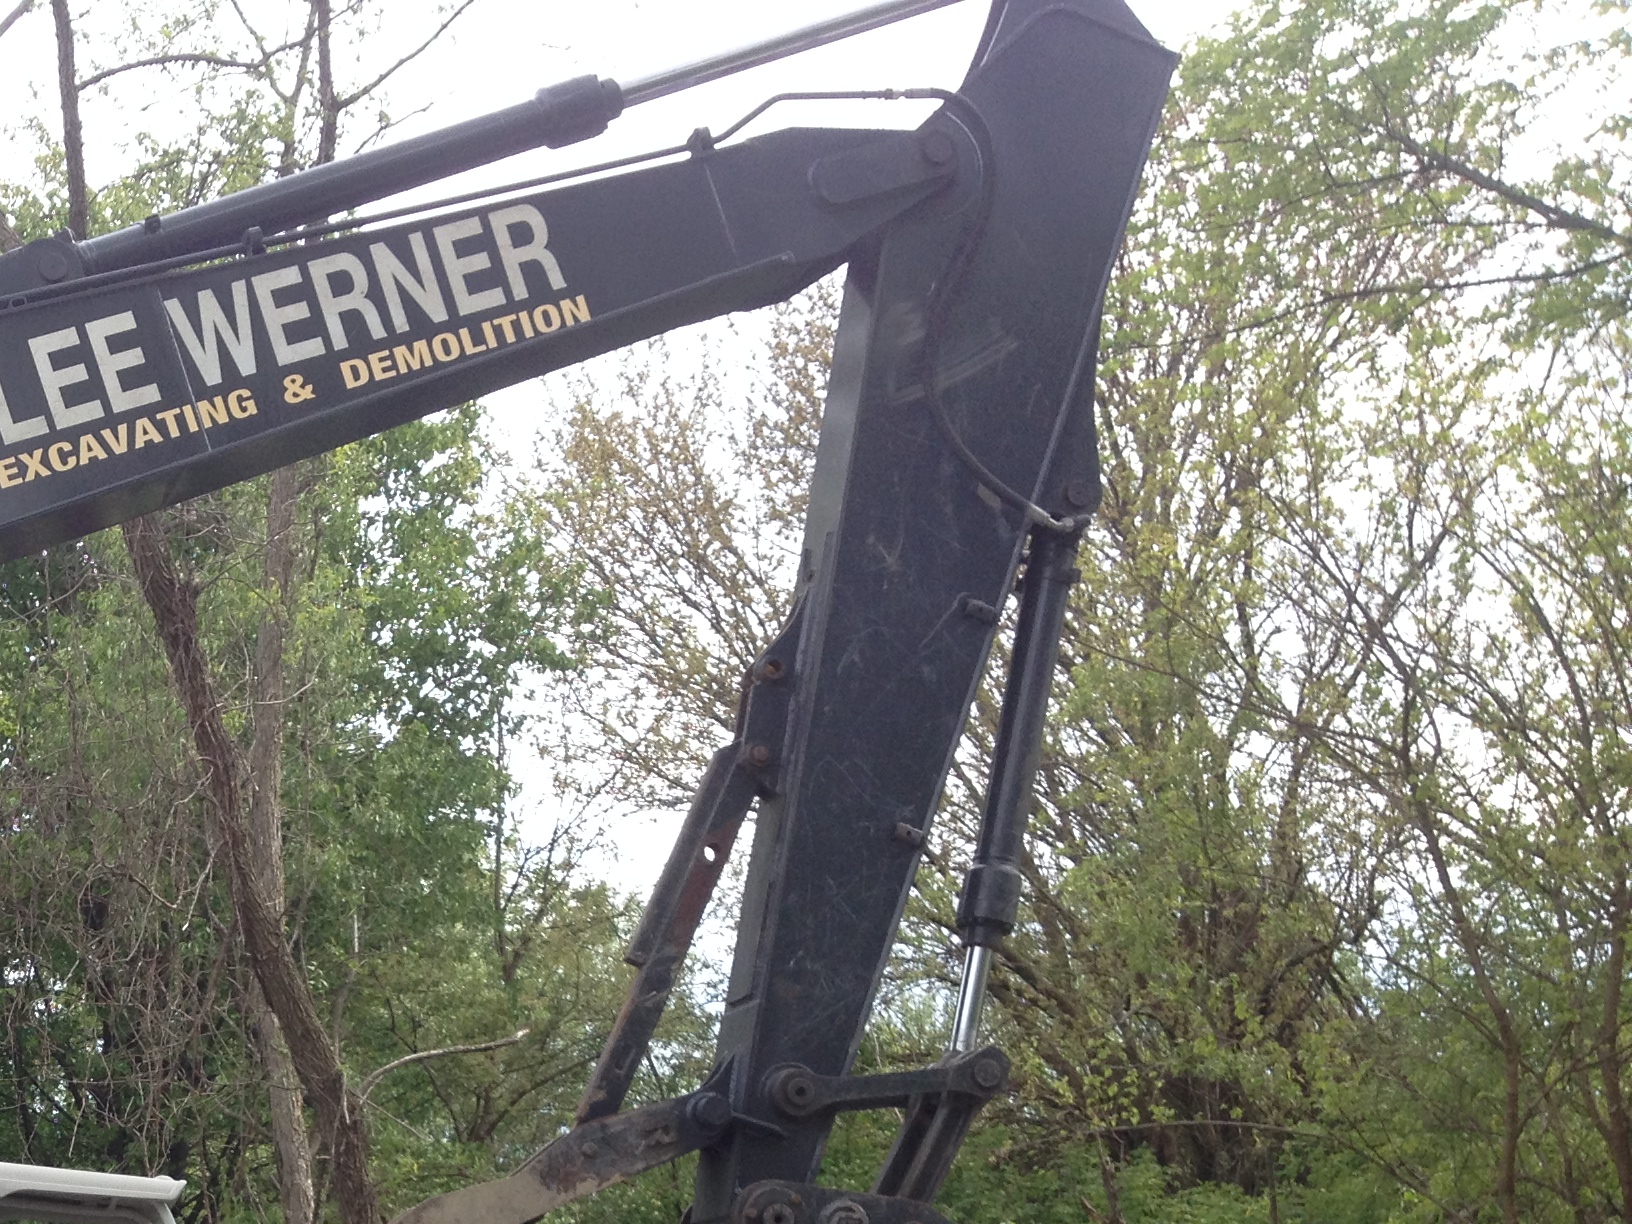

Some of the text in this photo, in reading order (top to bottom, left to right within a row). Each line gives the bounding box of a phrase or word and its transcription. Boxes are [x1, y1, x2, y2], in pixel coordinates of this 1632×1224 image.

[163, 203, 568, 387] WERNER
[282, 374, 317, 405] &
[340, 295, 593, 390] DEMOLITION
